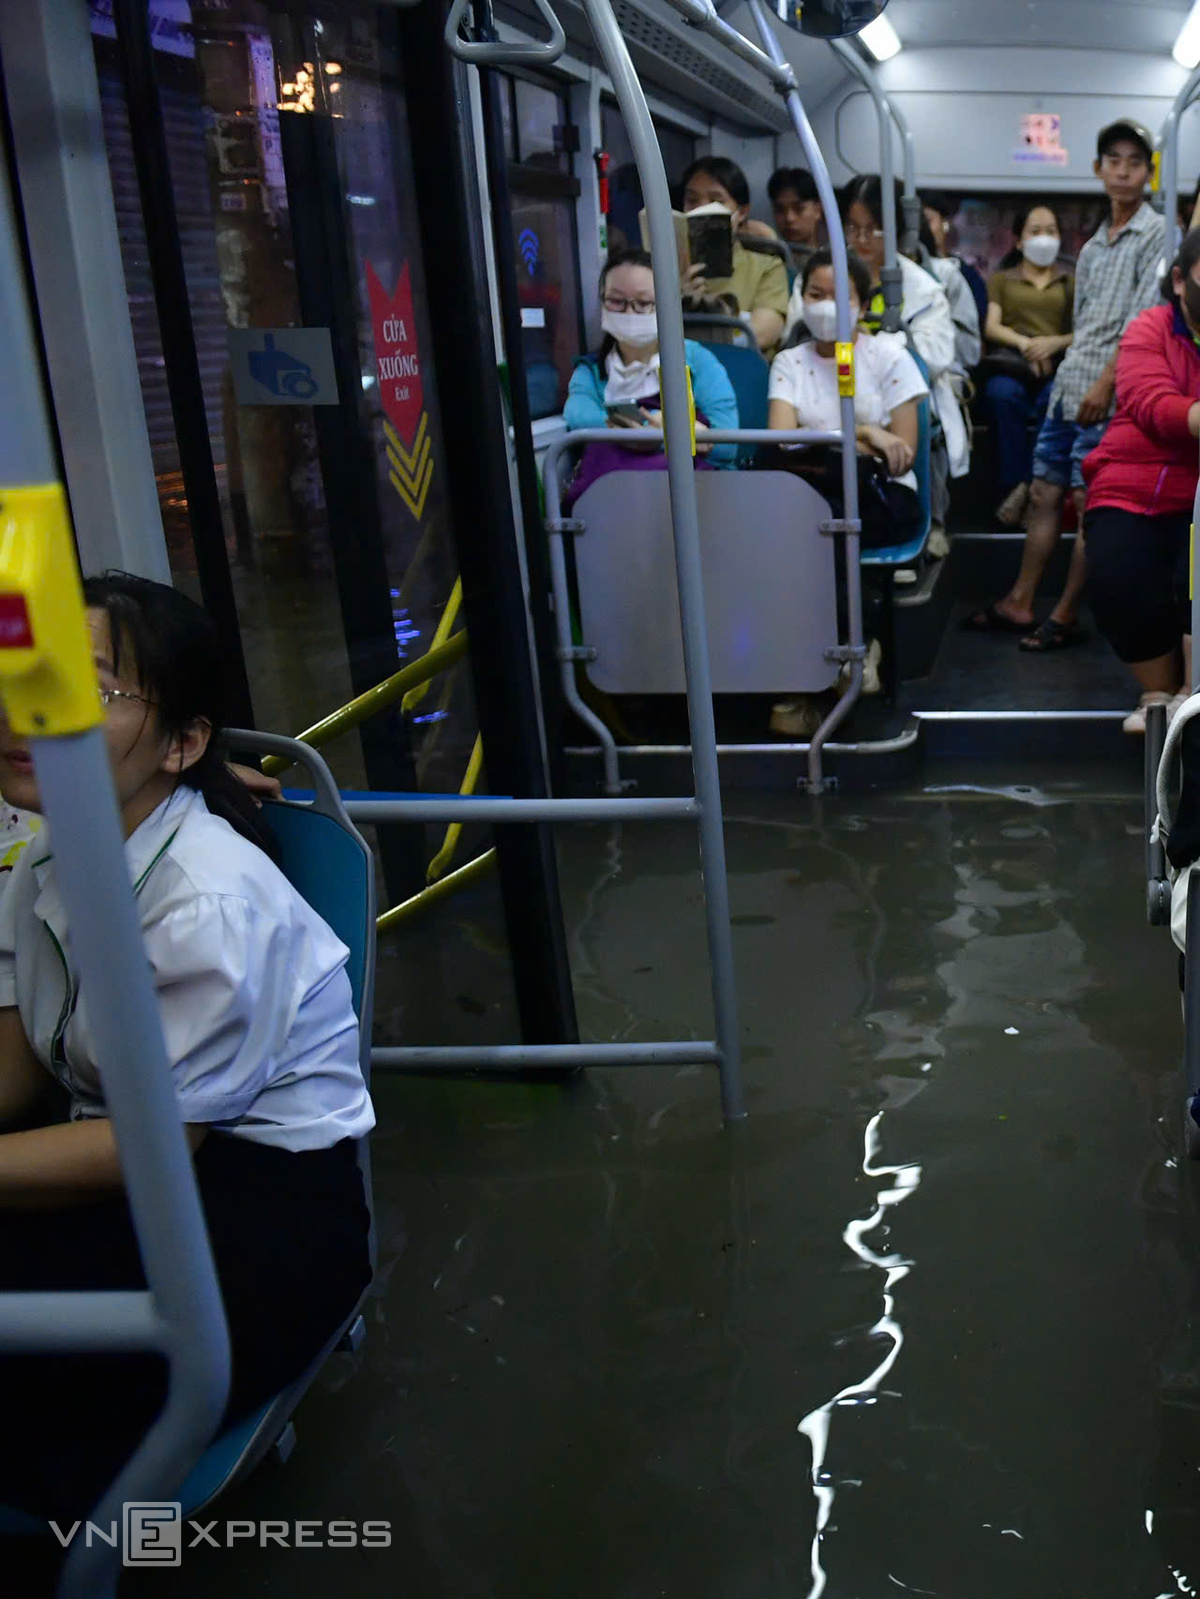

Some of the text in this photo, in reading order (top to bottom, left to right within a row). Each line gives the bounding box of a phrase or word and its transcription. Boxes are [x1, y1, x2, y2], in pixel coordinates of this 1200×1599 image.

[382, 313, 407, 343] CỬA
[378, 348, 419, 381] XUỐNG
[395, 385, 410, 402] Exit
